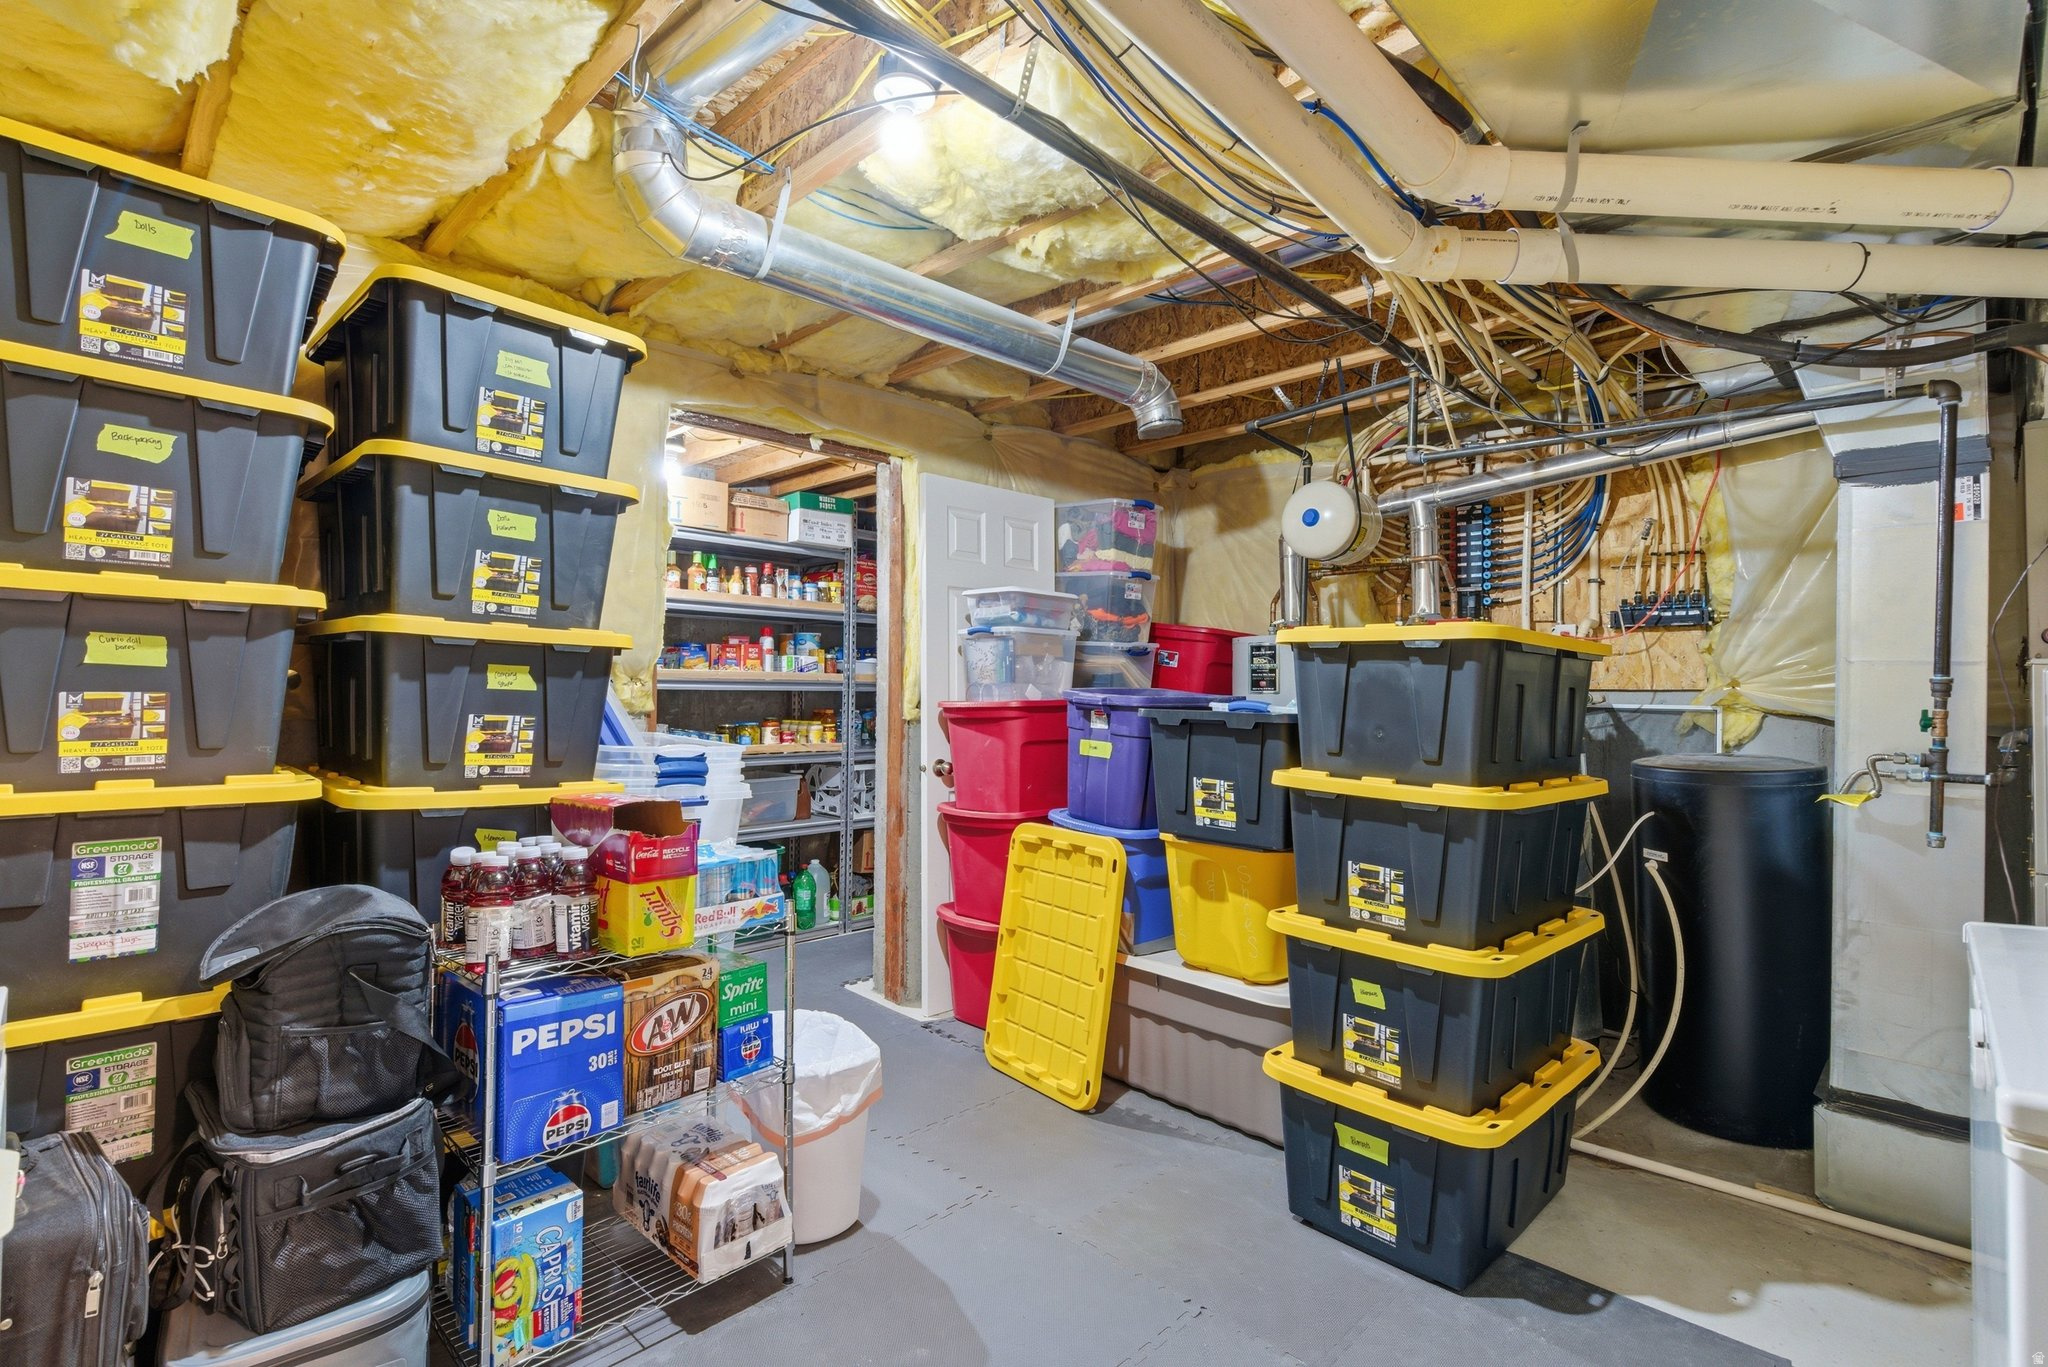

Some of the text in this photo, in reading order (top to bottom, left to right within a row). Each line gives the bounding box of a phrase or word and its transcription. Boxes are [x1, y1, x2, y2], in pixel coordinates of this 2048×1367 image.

[134, 219, 157, 236] Dolls
[76, 842, 155, 856] Greenmade
[662, 846, 691, 855] RECYCLE
[80, 860, 97, 871] NSF
[109, 852, 155, 863] STORAGE
[117, 864, 129, 873] 27
[74, 878, 121, 888] PROFESSIONAL
[454, 902, 465, 932] water
[581, 904, 591, 934] wate
[640, 887, 684, 938] Squirt
[694, 910, 715, 925] Red
[446, 901, 455, 943] vitamin
[631, 936, 642, 951] 12
[702, 966, 713, 977] 24
[722, 977, 764, 1002] Sprite
[730, 998, 758, 1017] mini
[512, 1010, 617, 1057] PEPSI
[71, 1047, 150, 1070] Greenmade
[104, 1059, 150, 1074] STORAGE
[454, 1048, 478, 1078] PEPSI
[588, 1055, 608, 1072] 30
[112, 1072, 124, 1082] 27
[653, 1064, 674, 1076] ROOT
[75, 1074, 92, 1085] NSF
[69, 1086, 117, 1102] PROFESSIONAL
[546, 1117, 589, 1141] PEPSI
[635, 1171, 662, 1201] fairlife
[514, 1221, 524, 1234] 10
[535, 1225, 565, 1286] CAPRI
